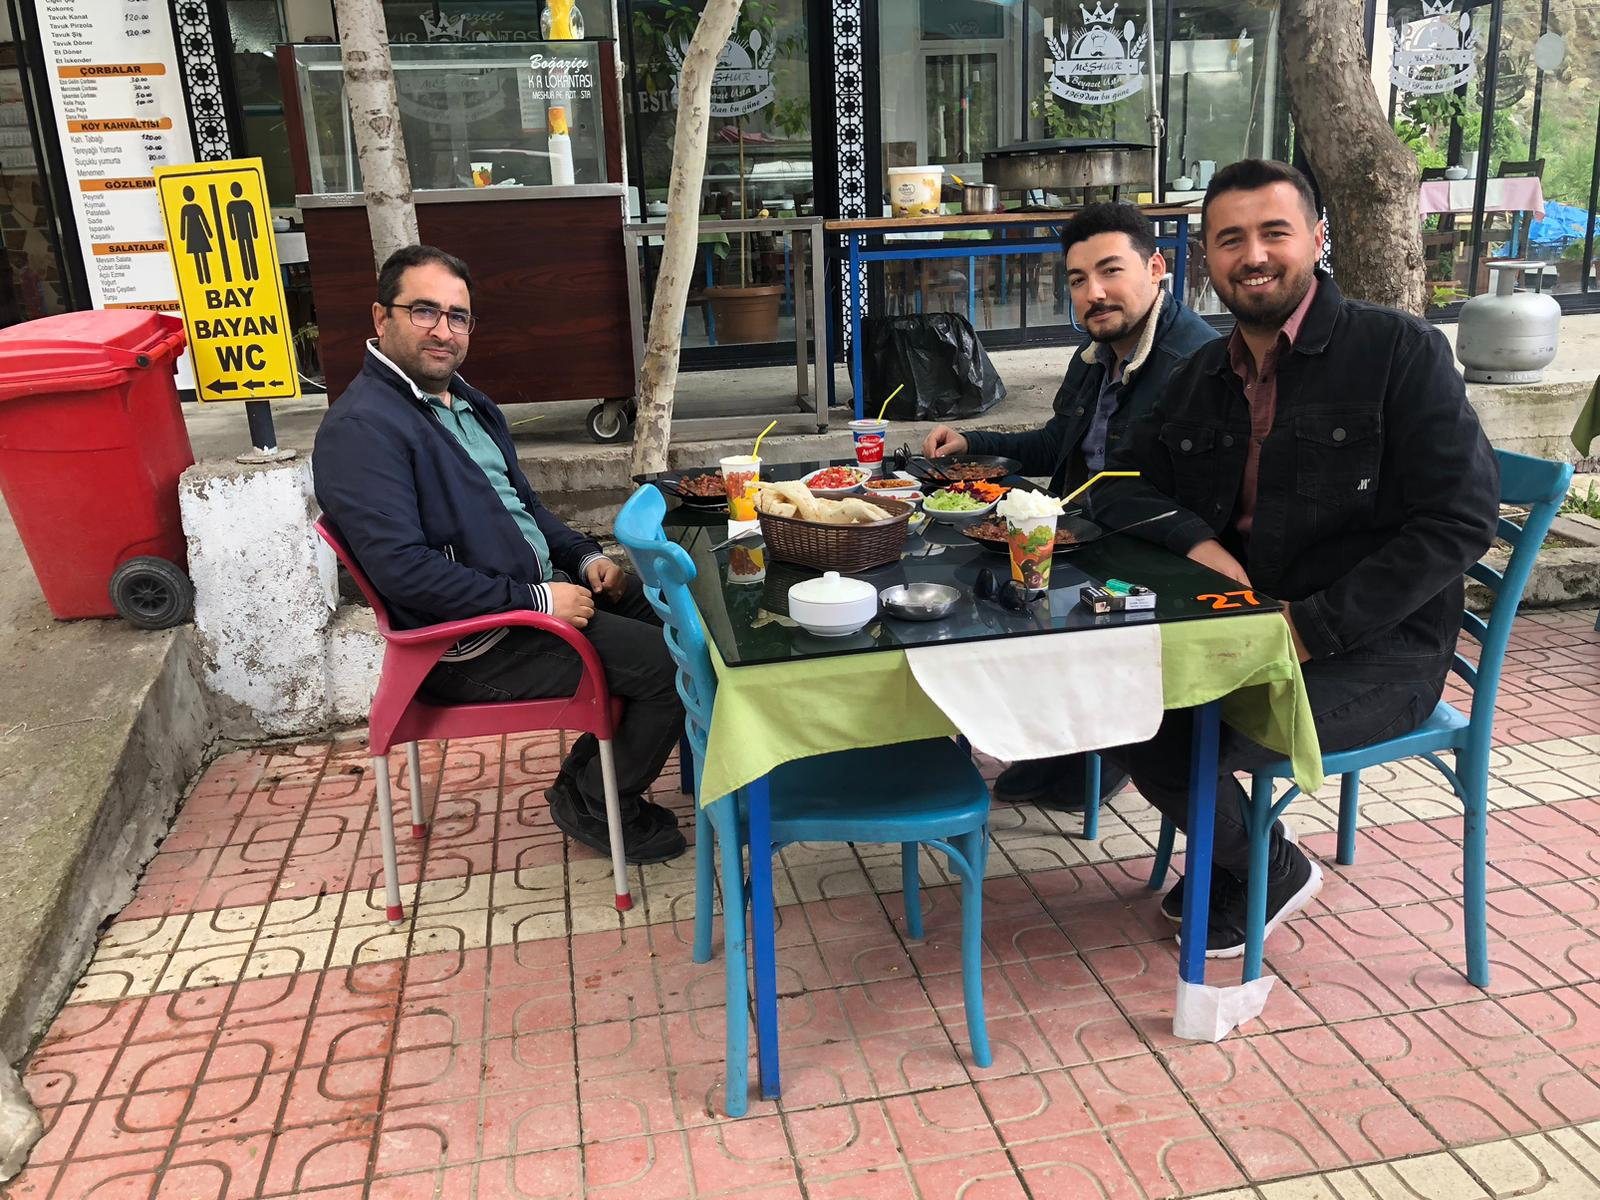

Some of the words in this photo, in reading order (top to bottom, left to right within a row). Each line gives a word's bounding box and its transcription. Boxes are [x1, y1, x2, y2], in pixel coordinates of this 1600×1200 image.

[80, 66, 141, 76] ÇORBALAR
[1071, 62, 1122, 74] MEŞHUR
[81, 121, 100, 131] KÖY
[104, 120, 160, 130] KAHVALTISI
[77, 169, 105, 177] Menemen
[105, 180, 156, 189] GÖZLEM
[109, 243, 165, 252] SALATALAR
[205, 287, 254, 309] BAY
[194, 315, 279, 339] BAYAN
[215, 344, 267, 372] WC
[1196, 590, 1261, 609] 27
